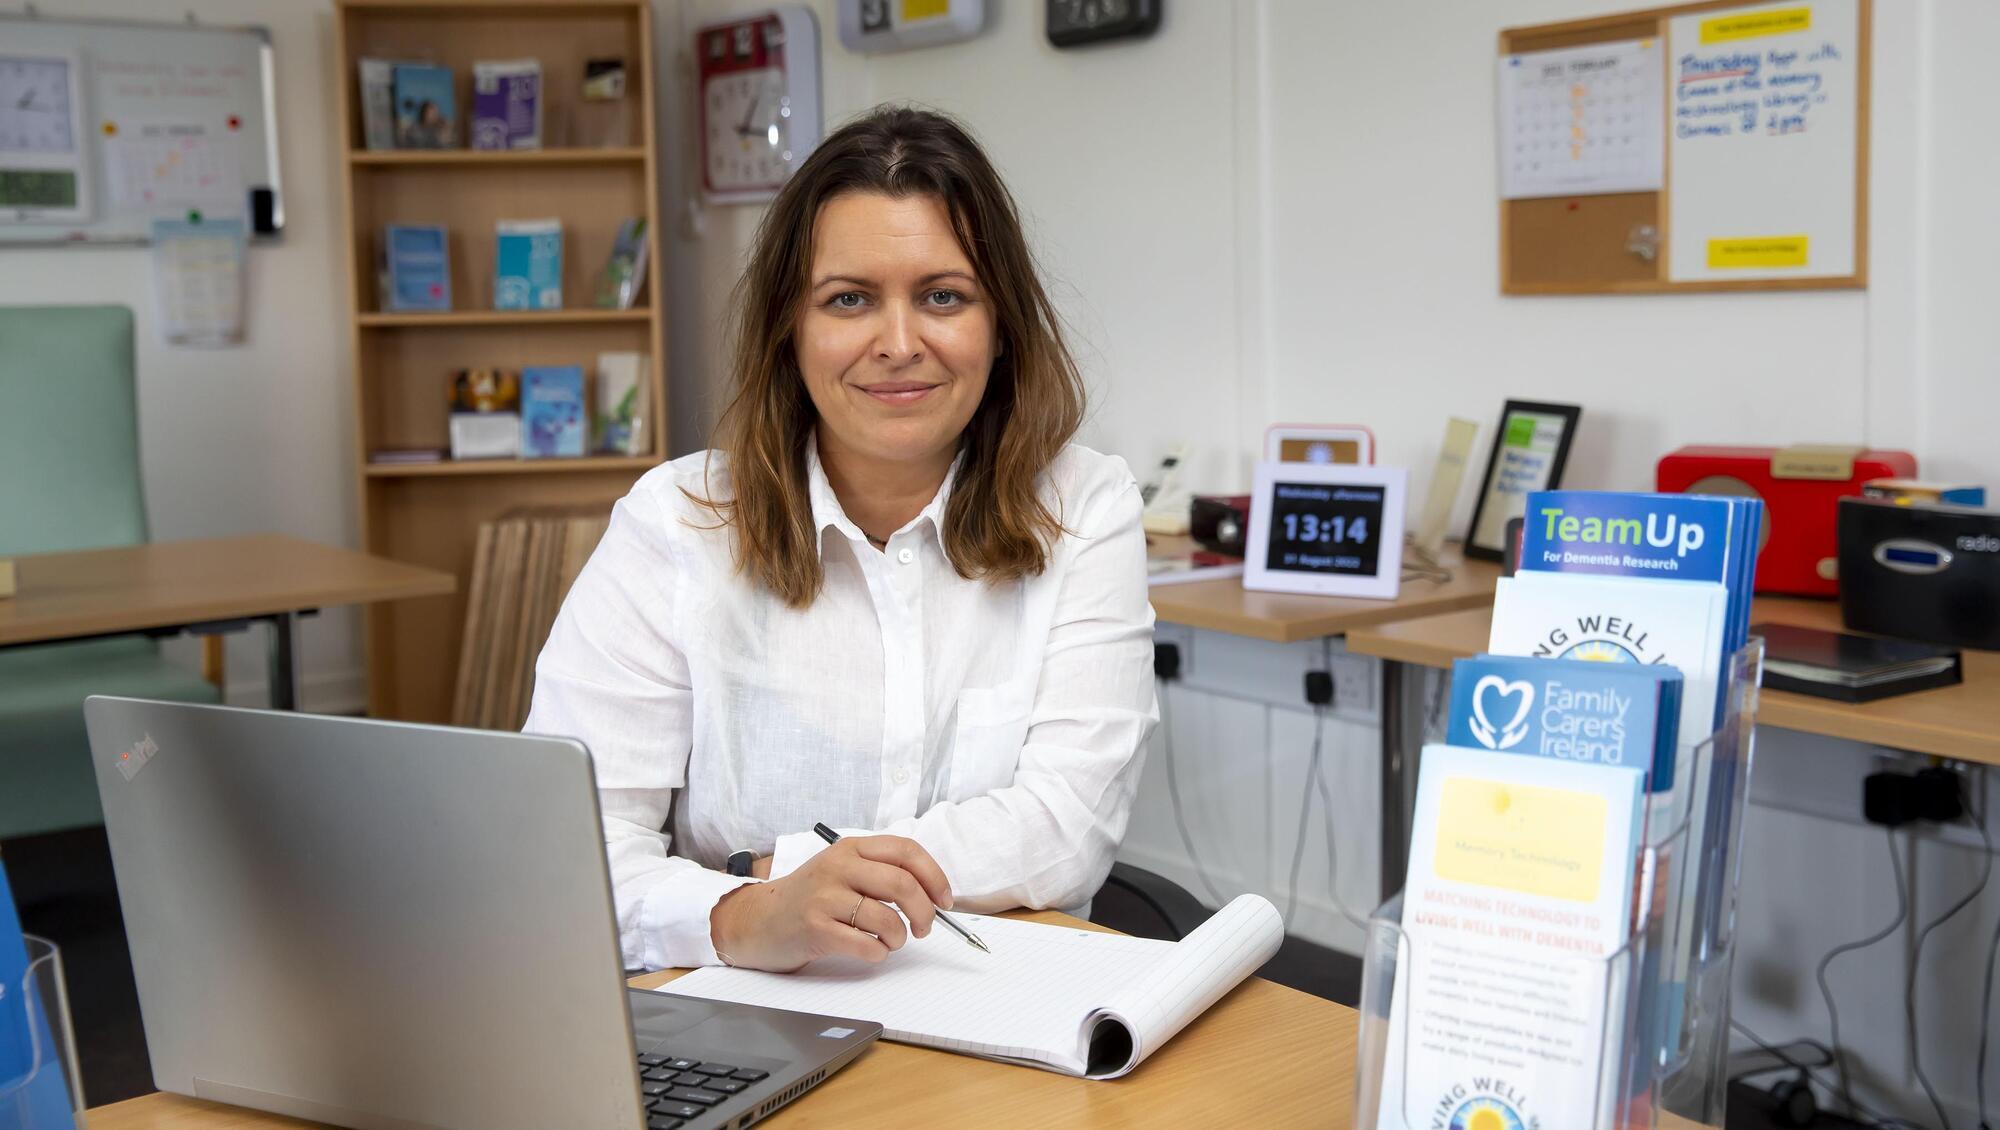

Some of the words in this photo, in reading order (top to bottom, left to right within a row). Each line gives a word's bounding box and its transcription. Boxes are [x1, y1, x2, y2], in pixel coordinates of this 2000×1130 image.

[1283, 513, 1368, 545] 13:14
[1543, 551, 1561, 563] For
[1563, 552, 1620, 567] Dementia
[1623, 555, 1678, 571] Research
[1577, 615, 1649, 652] WELL
[1544, 680, 1632, 721] Family
[1541, 705, 1627, 741] Carers
[1540, 731, 1624, 765] Ireland
[1424, 889, 1491, 913] MATCHING
[1496, 900, 1579, 928] TECHNOLOGY
[1584, 914, 1601, 931] TO
[1415, 911, 1457, 930] LIVING
[1462, 919, 1494, 937] WELL
[1499, 925, 1533, 943] WITH
[1536, 930, 1605, 956] DEMENTIA
[1472, 1077, 1526, 1111] WELL
